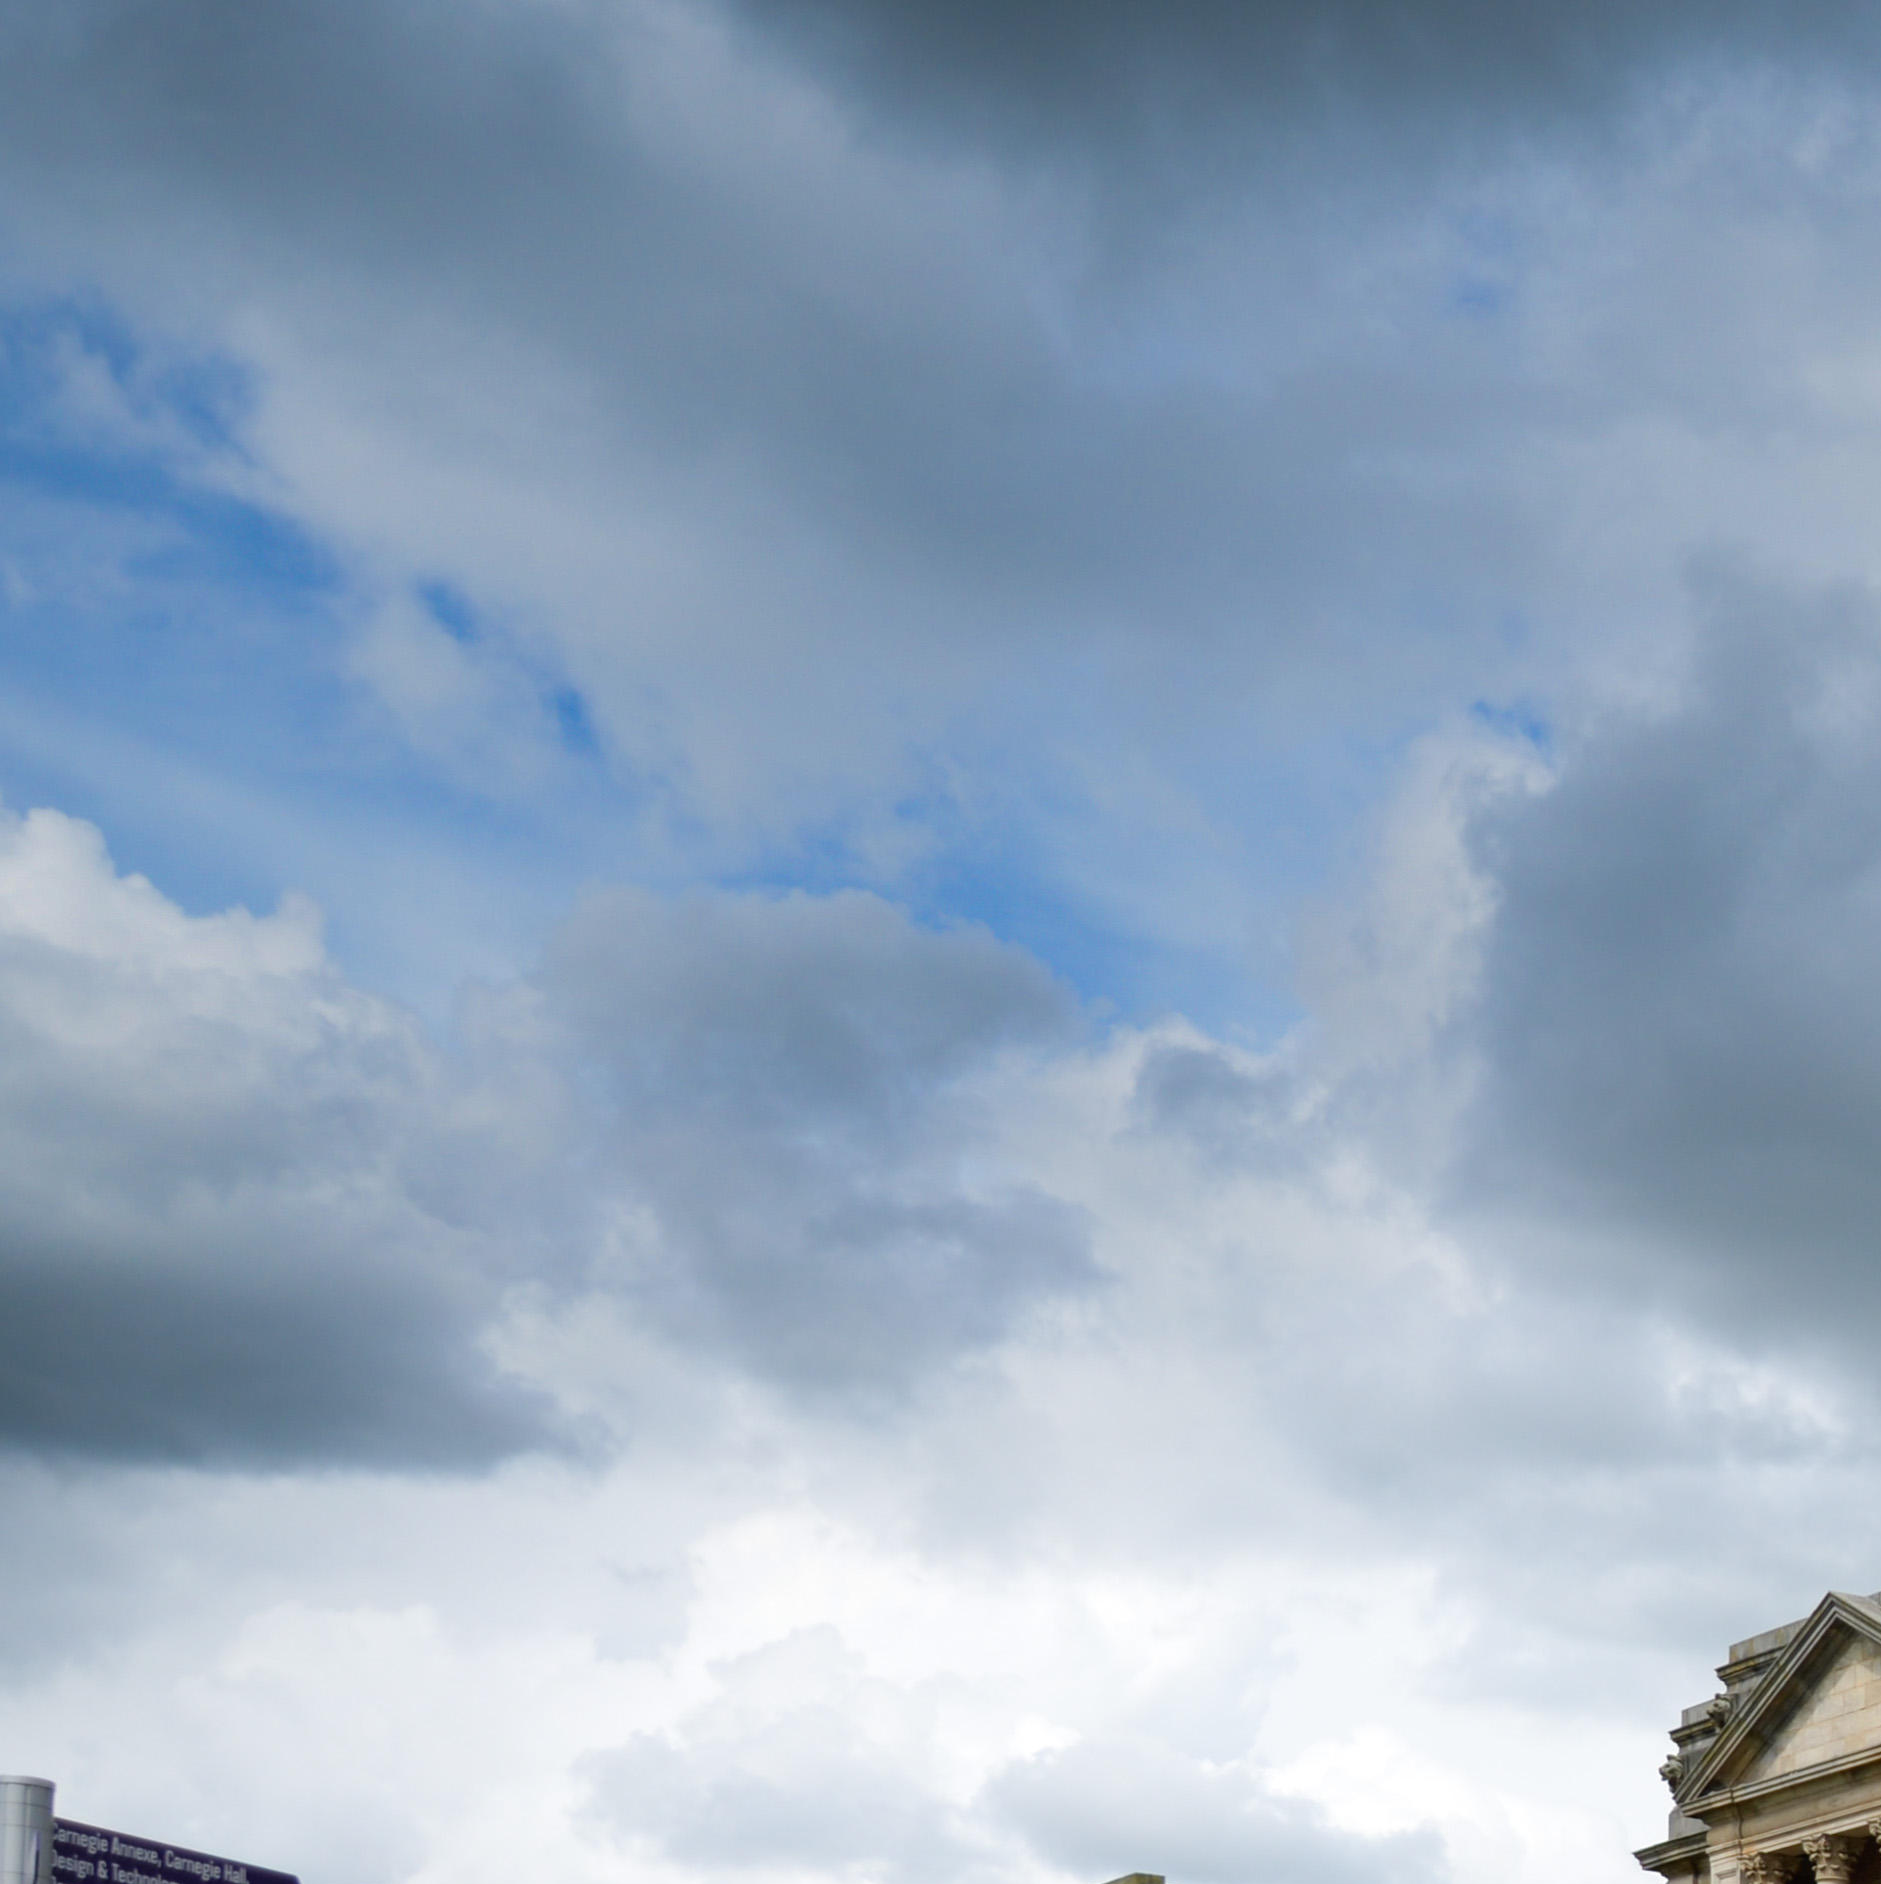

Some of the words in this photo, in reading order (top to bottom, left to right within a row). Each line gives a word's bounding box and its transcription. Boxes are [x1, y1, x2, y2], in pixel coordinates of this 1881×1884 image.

[97, 1860, 109, 1879] &
[111, 1836, 162, 1869] Annexe,
[165, 1849, 221, 1882] Carnegie
